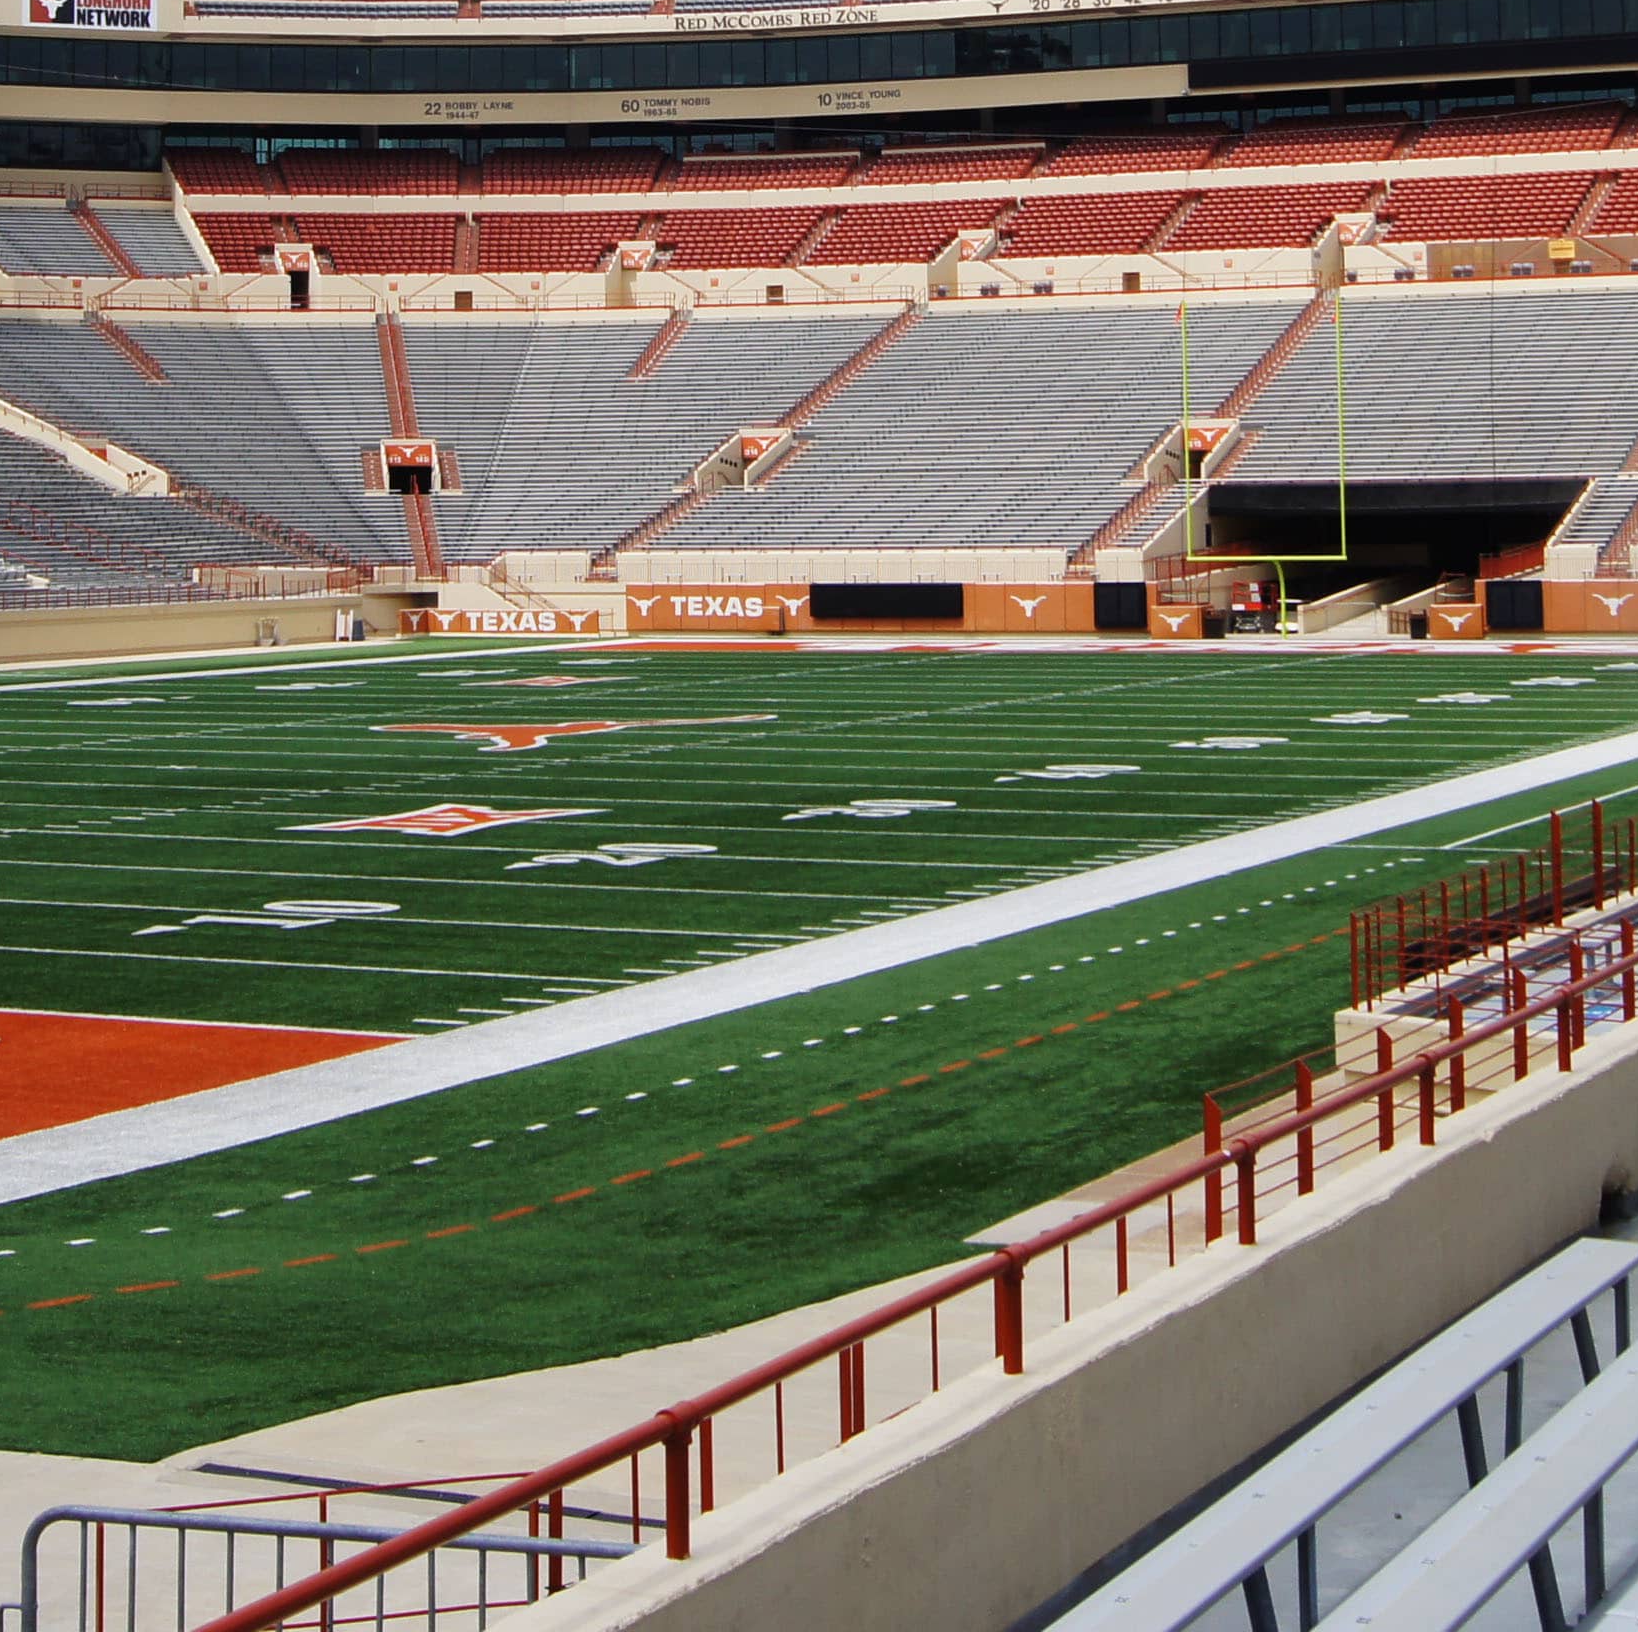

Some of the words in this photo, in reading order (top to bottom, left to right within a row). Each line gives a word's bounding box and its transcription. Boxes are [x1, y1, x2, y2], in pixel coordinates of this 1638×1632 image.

[76, 9, 150, 27] NETWORK
[621, 99, 640, 113] 60
[644, 99, 677, 107] TOMMY
[681, 97, 710, 106] NOBIS
[817, 93, 832, 107] 10
[836, 91, 864, 100] VINCE
[868, 89, 901, 98] YOUNG
[424, 102, 441, 115] 22
[445, 102, 478, 110] BOBBY
[483, 102, 514, 110] LAYNE
[670, 596, 763, 617] TEXAS
[465, 612, 556, 632] TEXAS
[531, 842, 718, 867] 20
[182, 900, 401, 930] 10
